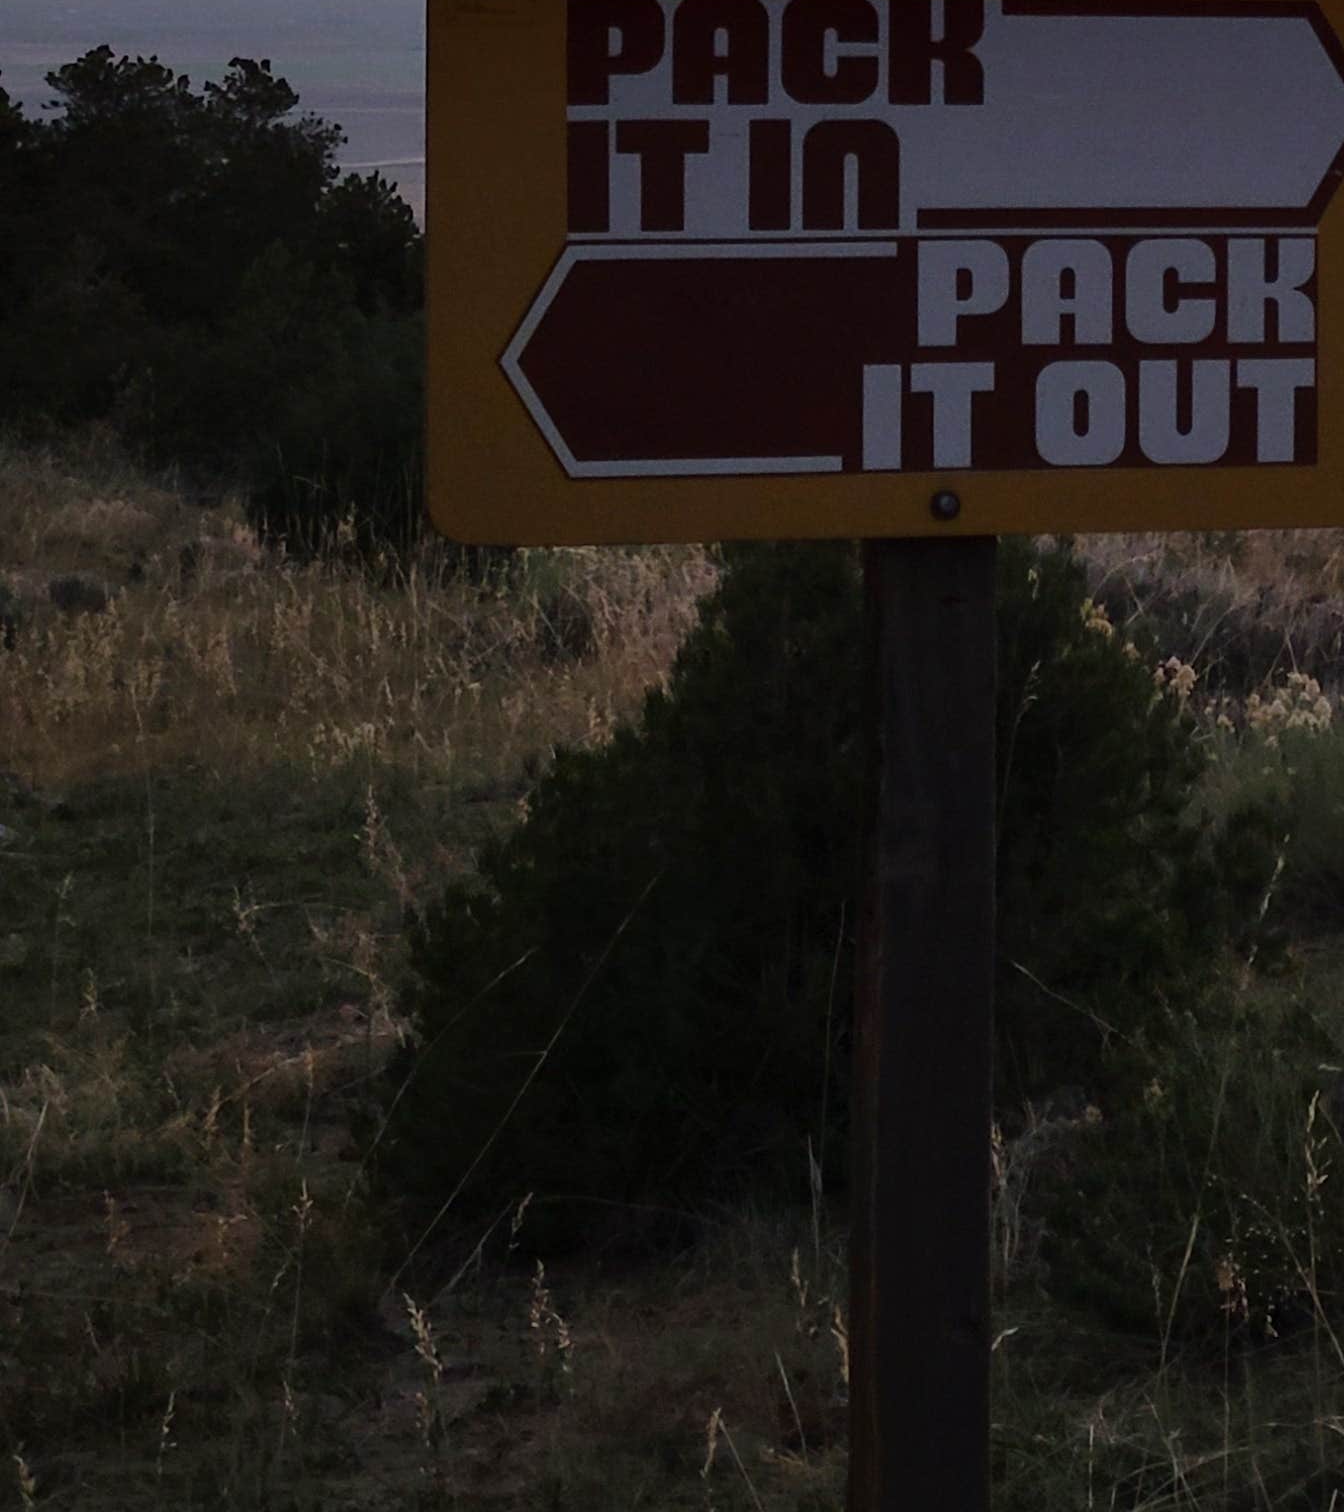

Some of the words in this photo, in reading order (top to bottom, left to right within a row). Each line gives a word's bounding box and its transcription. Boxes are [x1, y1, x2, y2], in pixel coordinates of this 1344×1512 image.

[568, 120, 709, 232] IT
[749, 119, 900, 230] IN
[916, 239, 1314, 346] PACK
[862, 363, 995, 469] IT
[1035, 359, 1314, 466] OUT
